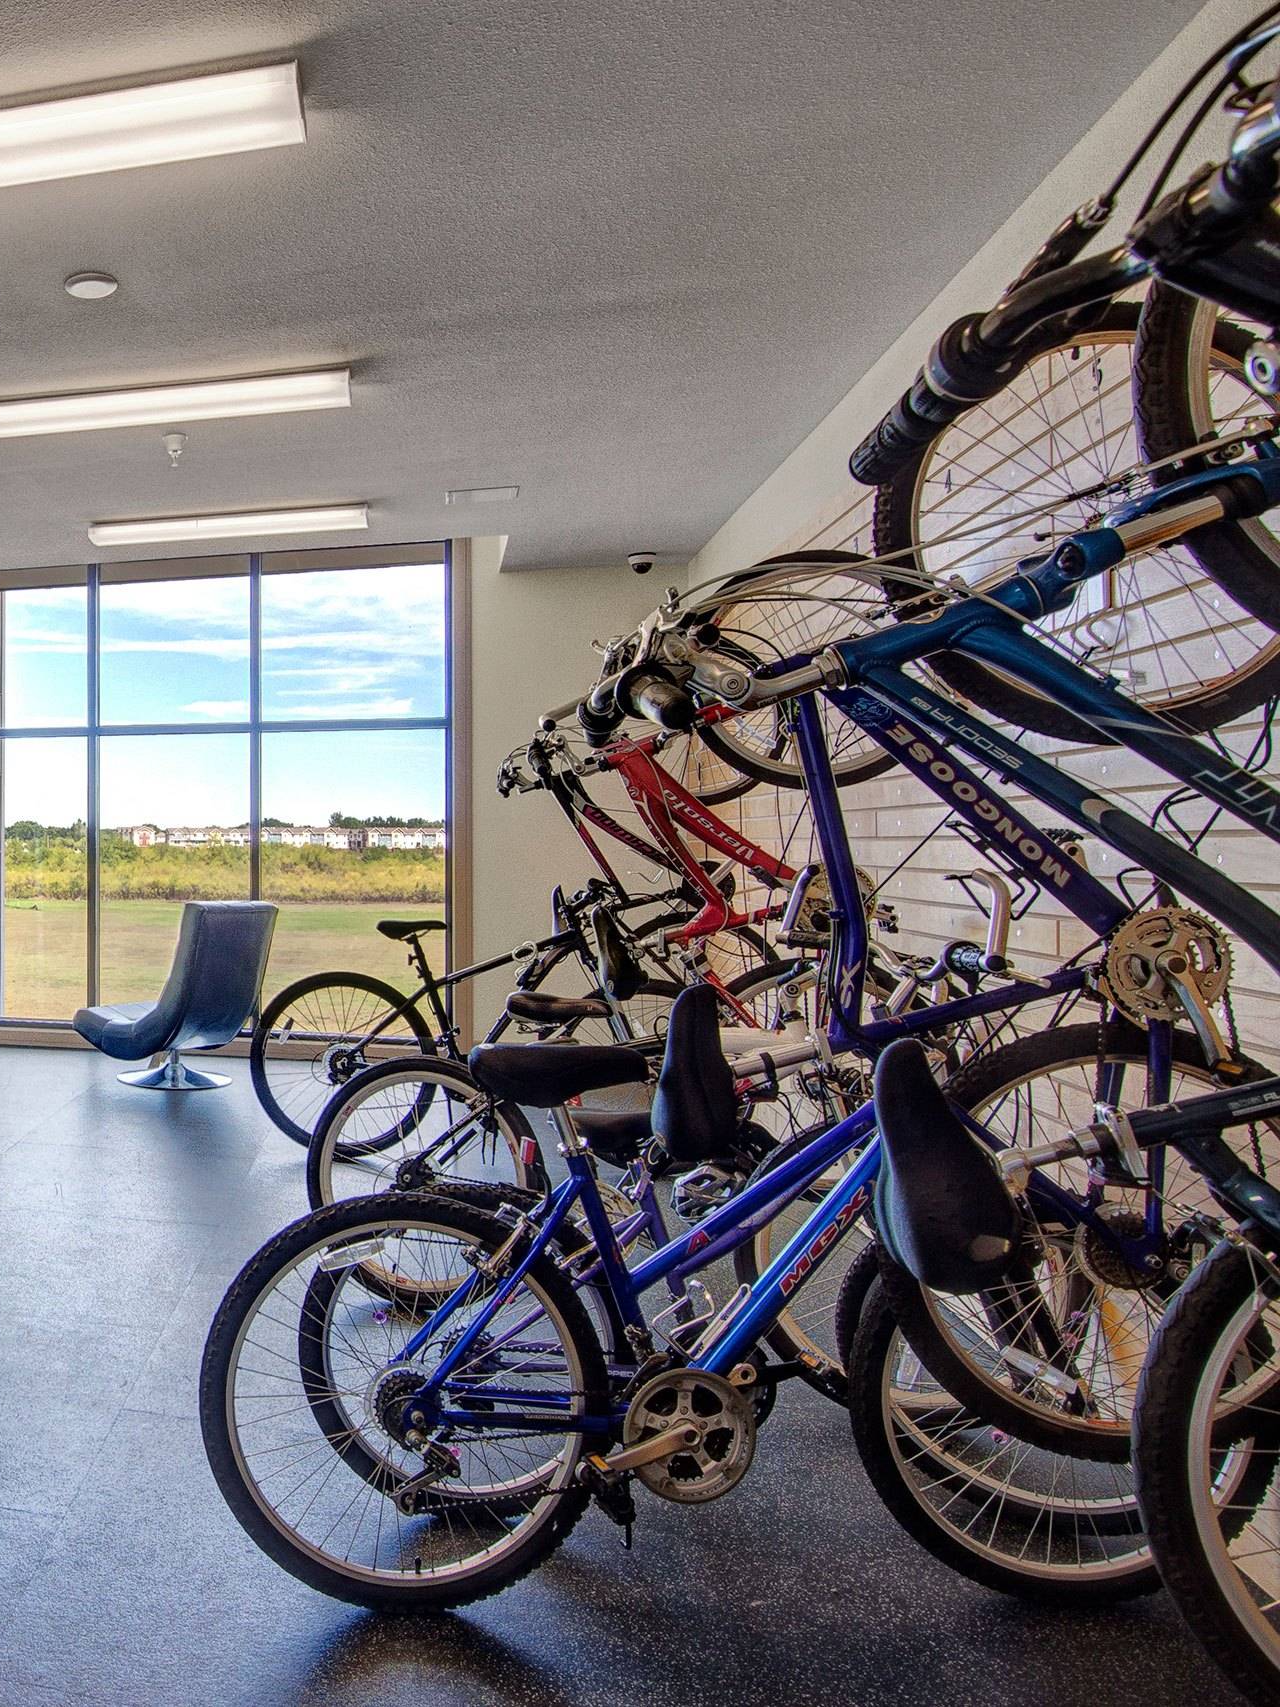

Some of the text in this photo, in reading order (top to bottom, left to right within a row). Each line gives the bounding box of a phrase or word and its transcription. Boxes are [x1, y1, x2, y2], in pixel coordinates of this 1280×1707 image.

[926, 707, 1024, 769] SEDONA
[885, 722, 1071, 889] MONGOOSE
[779, 1185, 869, 1297] MGX
